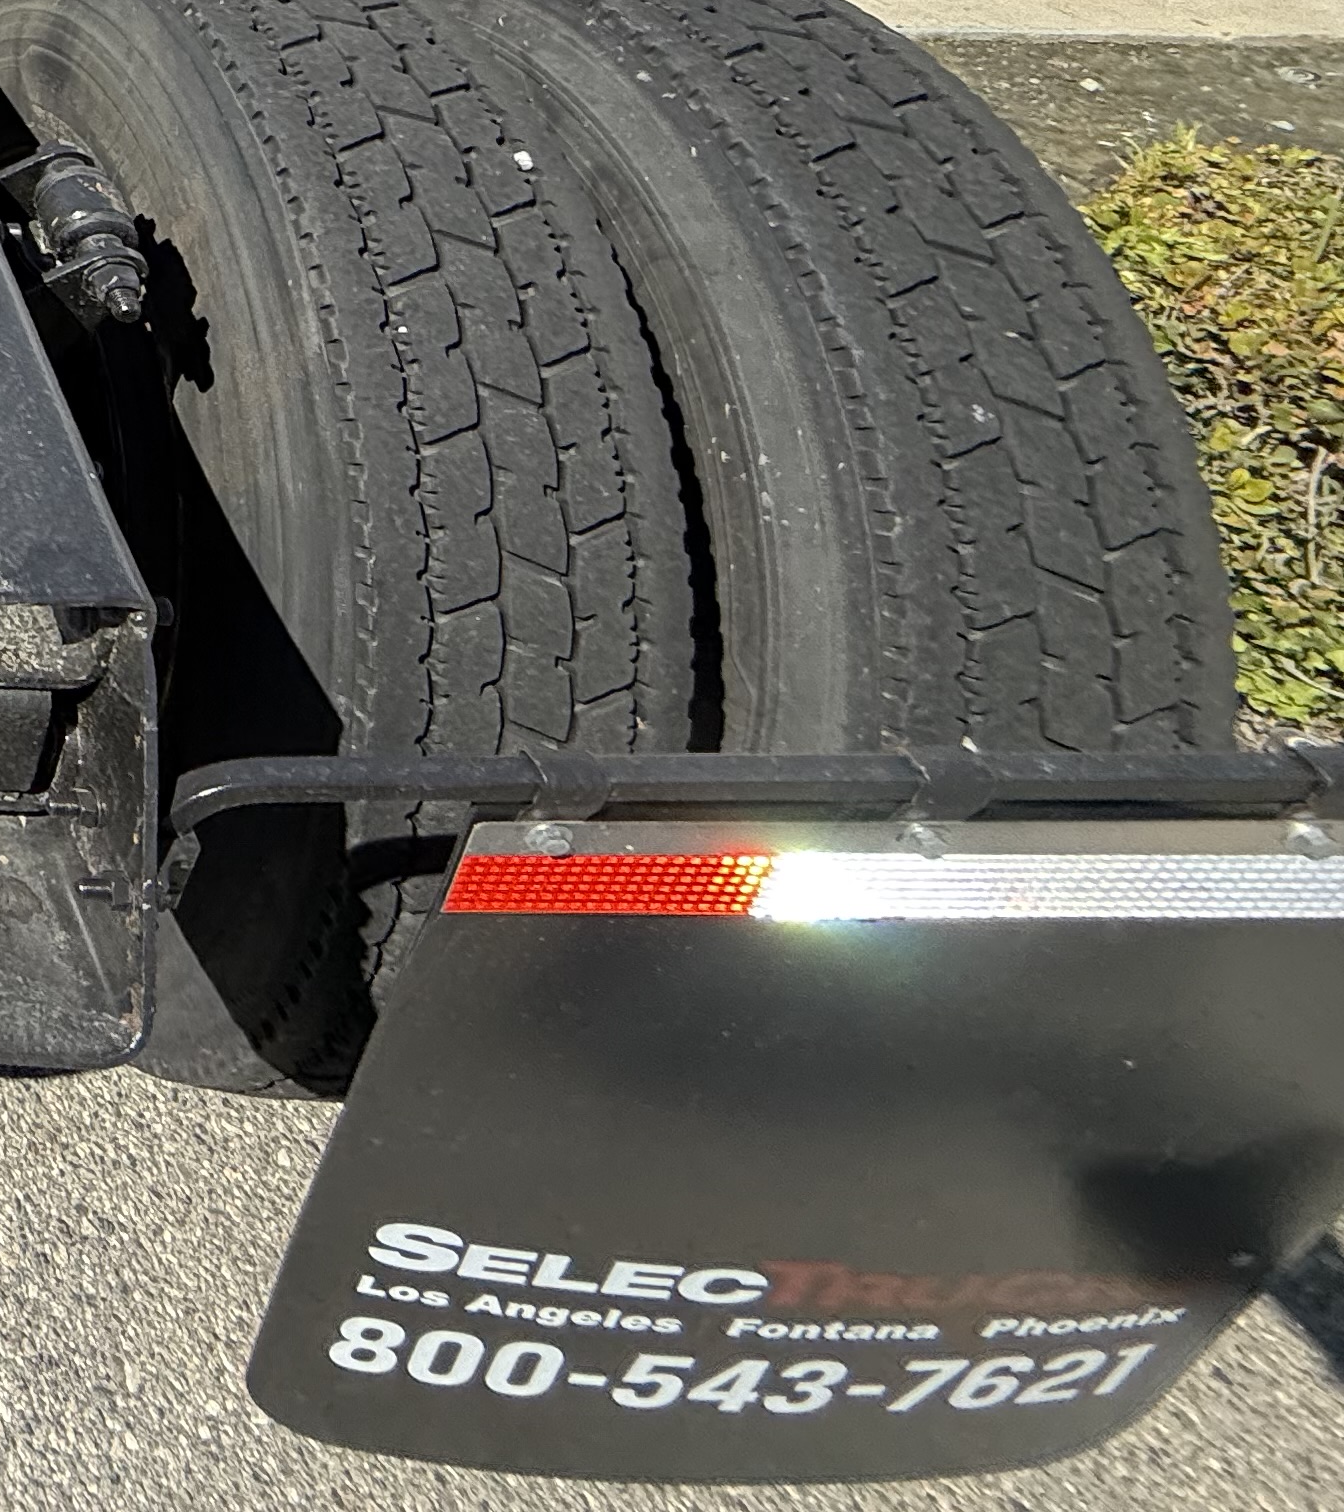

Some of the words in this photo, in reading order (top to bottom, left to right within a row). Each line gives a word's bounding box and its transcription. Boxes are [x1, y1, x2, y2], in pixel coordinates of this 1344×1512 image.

[356, 1275, 450, 1307] Los
[464, 1294, 683, 1334] Angeles
[726, 1317, 940, 1341] Fontana
[979, 1304, 1188, 1339] Phoenix
[329, 1316, 1156, 1414] 800-543-7621
